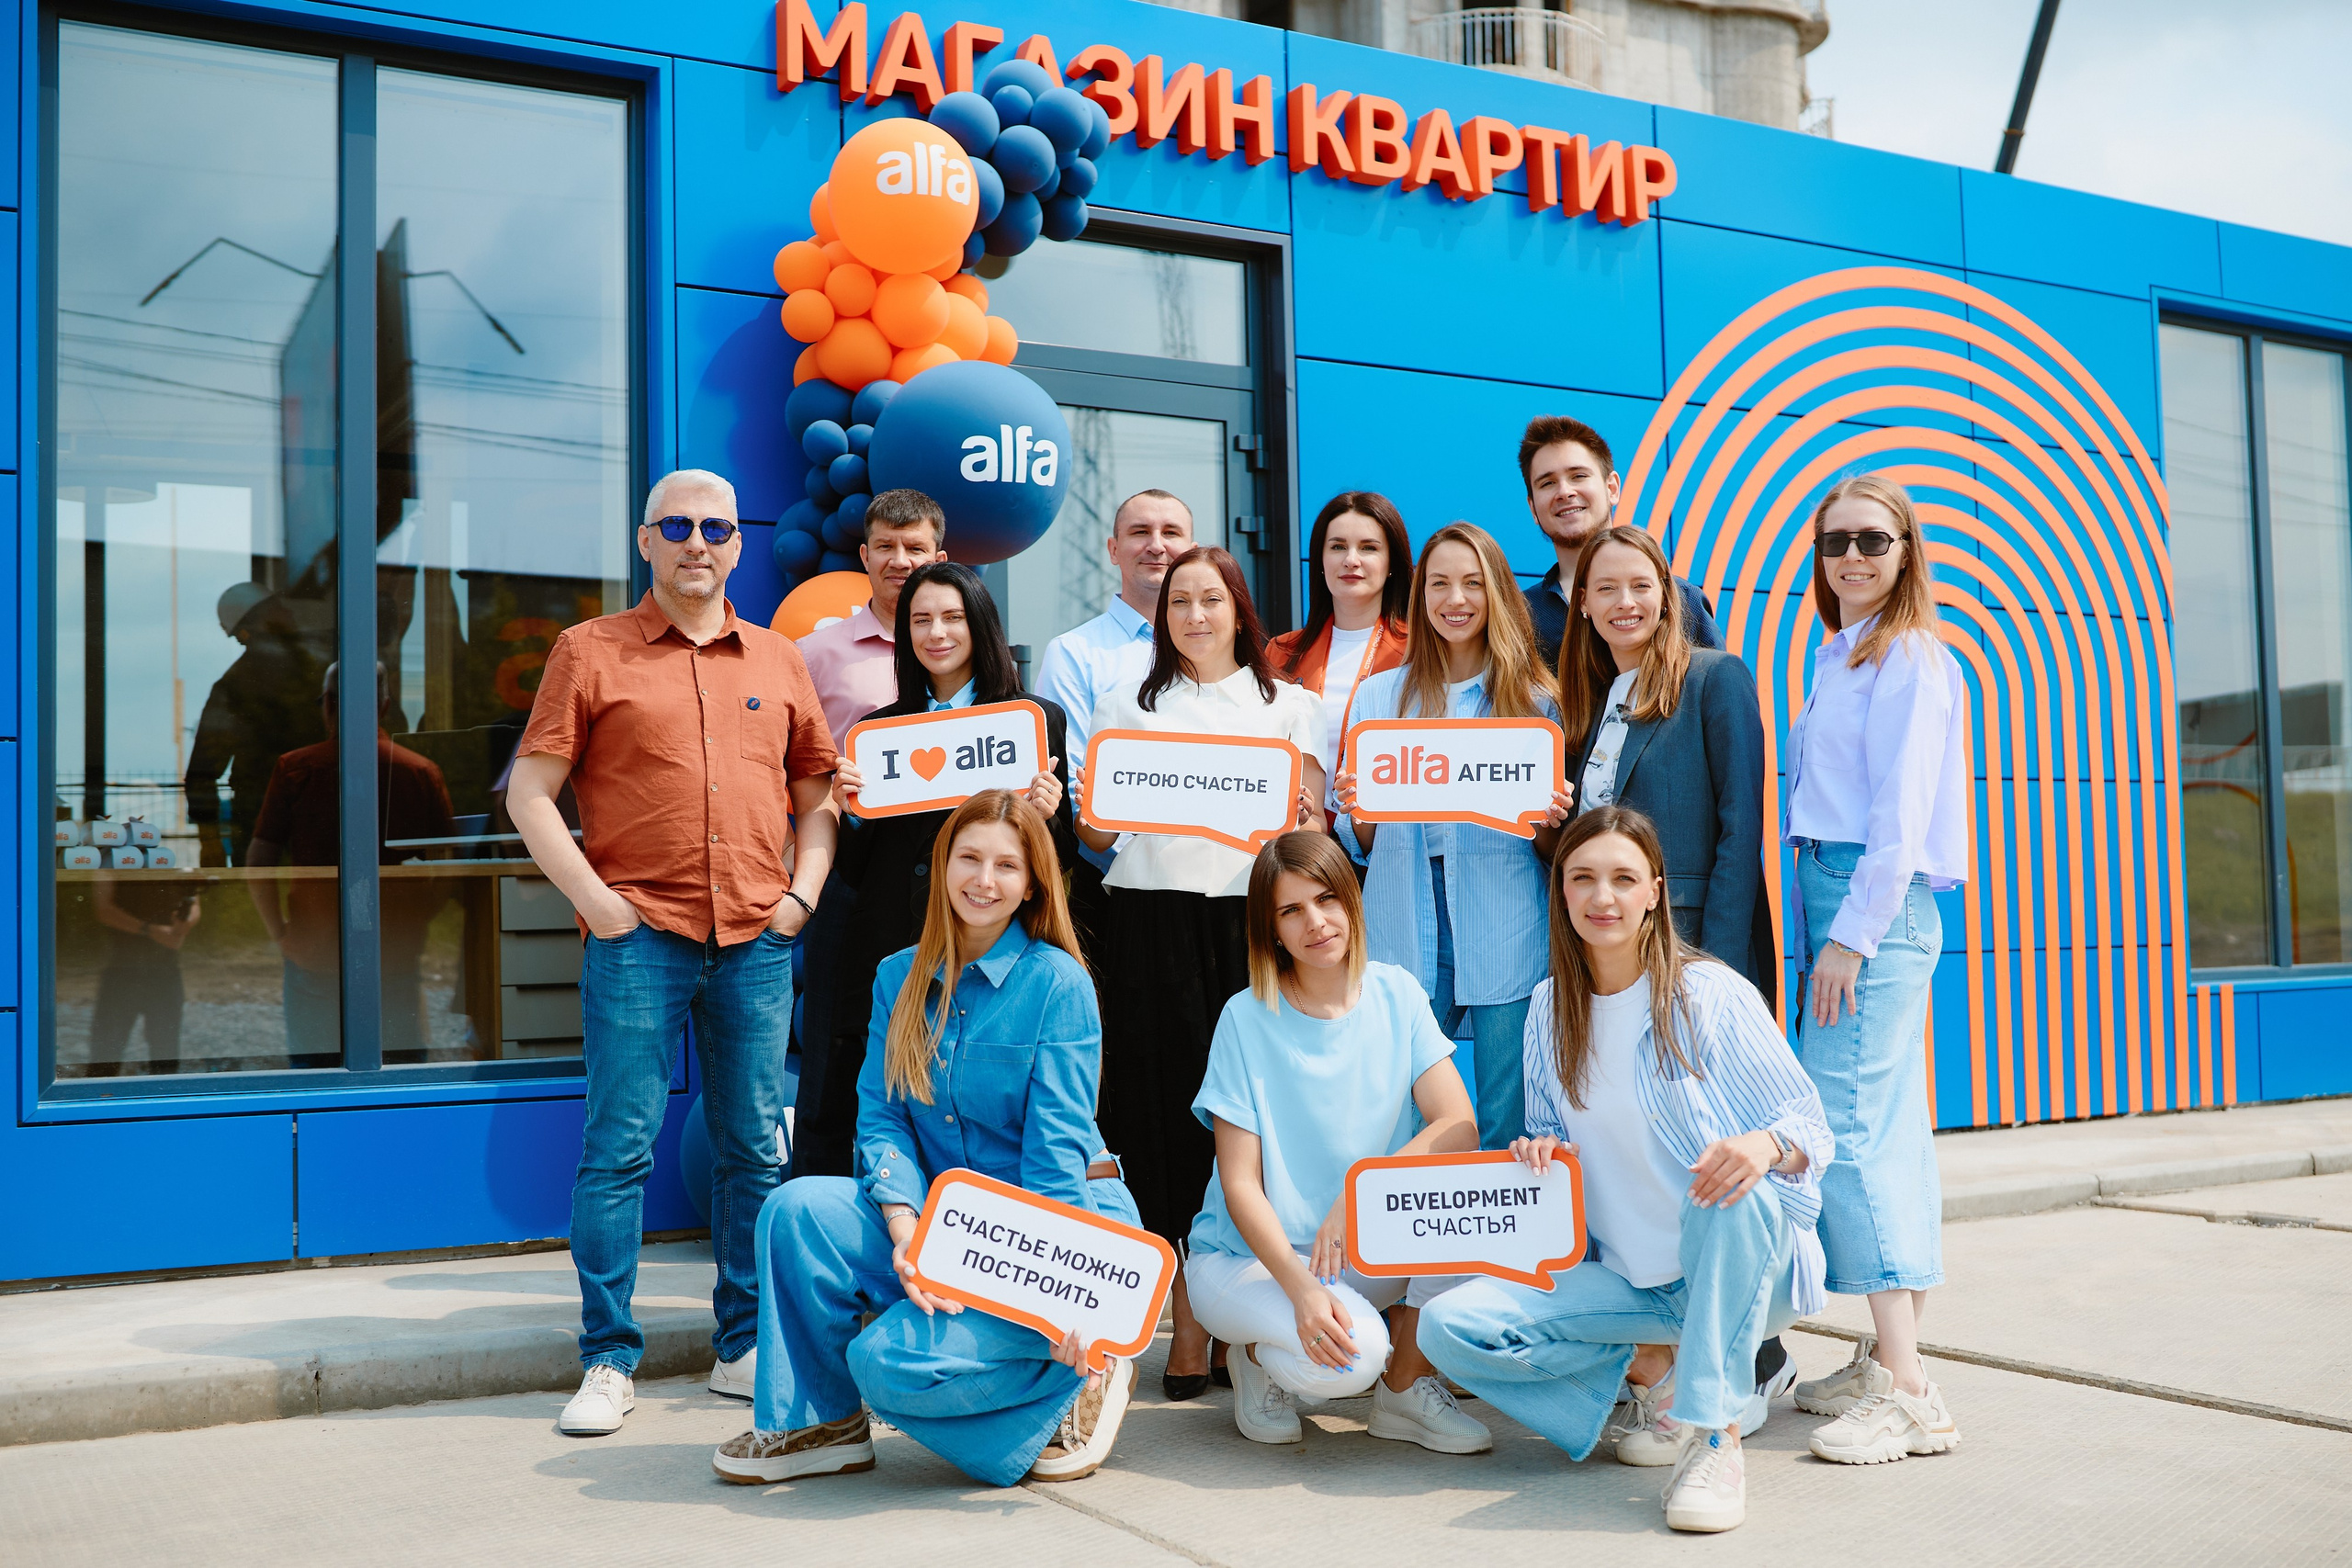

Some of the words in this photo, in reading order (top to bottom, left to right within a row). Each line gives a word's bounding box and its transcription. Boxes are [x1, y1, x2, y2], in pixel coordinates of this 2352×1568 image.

[876, 141, 971, 205] alfa
[1288, 83, 1678, 227] КВАРТИР
[960, 423, 1058, 487] alfa
[881, 749, 901, 780] I
[956, 735, 1017, 771] alfa
[1113, 770, 1179, 788] СТРОЮ
[1183, 774, 1268, 794] СЧАСТЬЕ
[1372, 745, 1450, 785] alfa
[1457, 762, 1536, 783] АГЕНТ
[1385, 1186, 1541, 1213] DEVELOPMENT
[1412, 1214, 1517, 1237] СЧАСТЬЯ
[942, 1208, 1048, 1258] СЧАСТЬЕ
[1050, 1245, 1141, 1290] МОЖНО
[961, 1248, 1100, 1310] ПОСТРОИТЬ
